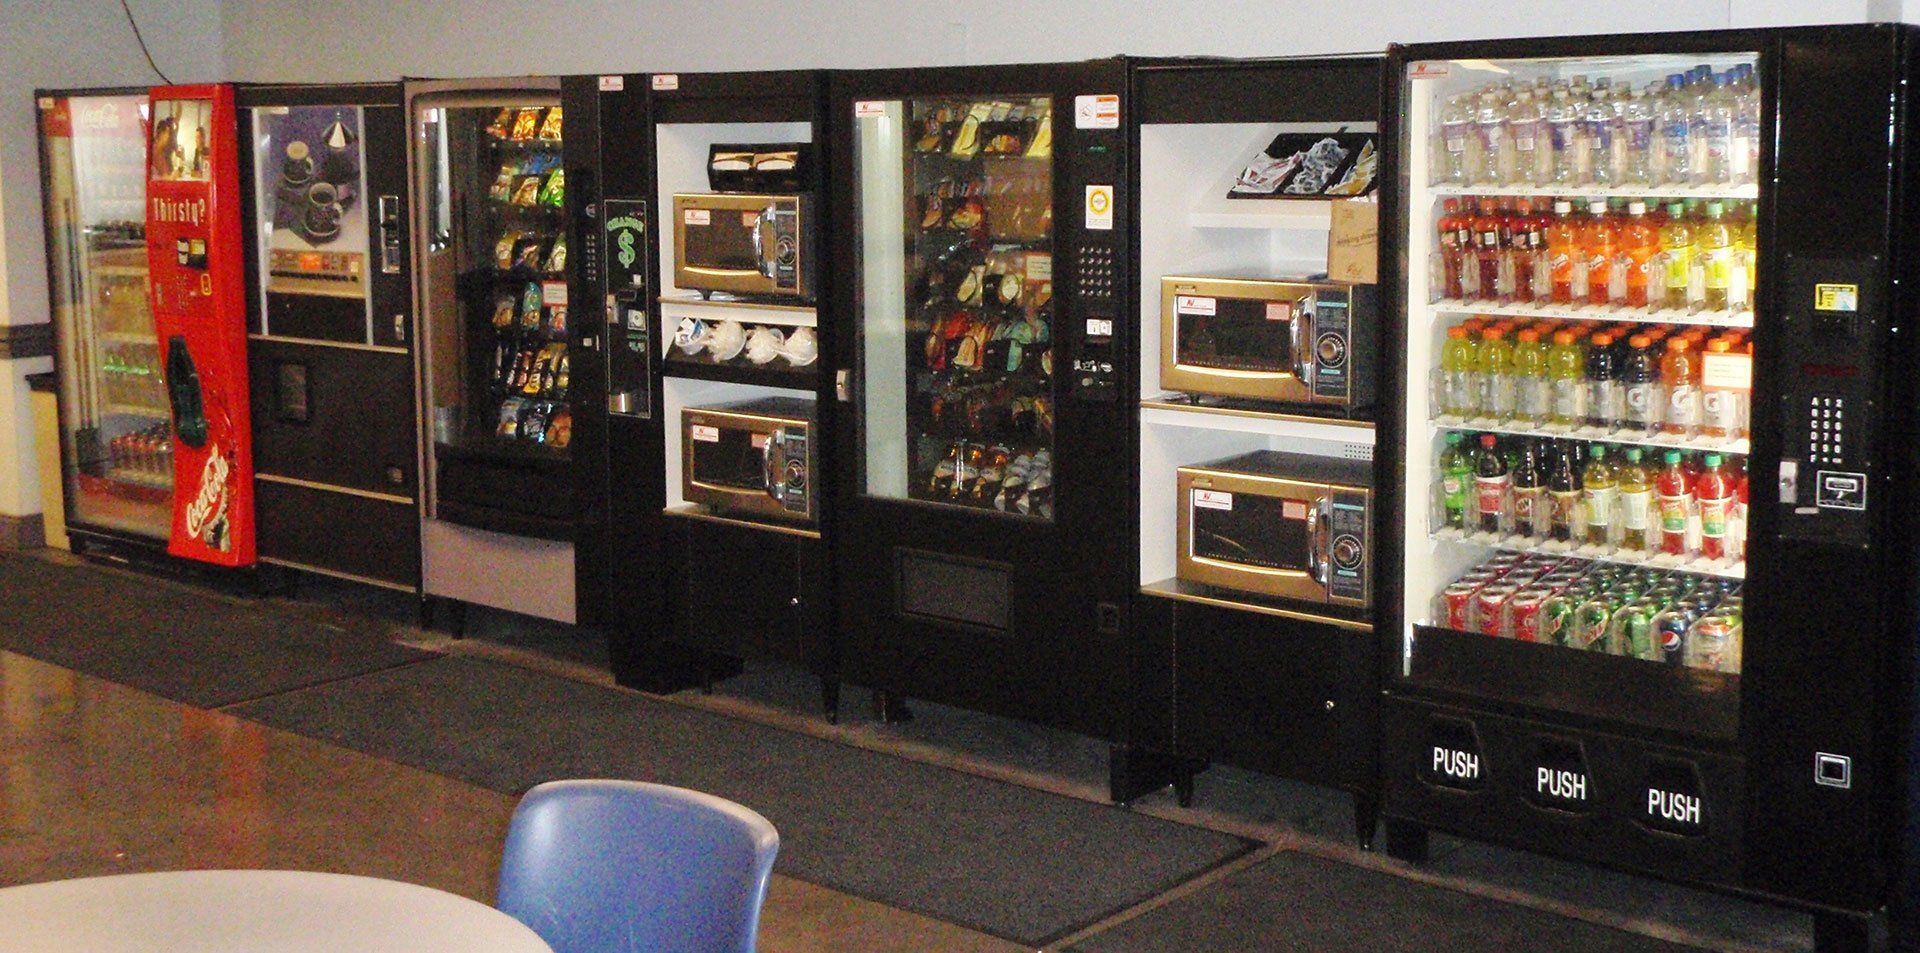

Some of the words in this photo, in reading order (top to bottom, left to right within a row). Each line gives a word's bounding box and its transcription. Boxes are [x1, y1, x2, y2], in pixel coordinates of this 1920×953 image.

[153, 197, 206, 227] Thirsty?
[1811, 397, 1819, 406] A
[1823, 398, 1830, 407] 1
[1835, 399, 1843, 408] 2
[1823, 409, 1830, 418] 3
[1835, 410, 1842, 419] 4
[1811, 420, 1818, 429] C
[1823, 421, 1830, 430] 5
[1811, 431, 1818, 441] D
[1823, 432, 1829, 441] 7
[1810, 442, 1818, 452] E
[1810, 454, 1817, 463] F
[186, 442, 229, 539] Coca-Cola
[1433, 746, 1479, 779] PUSH
[1537, 767, 1586, 800] PUSH
[1648, 788, 1700, 824] PUSH
